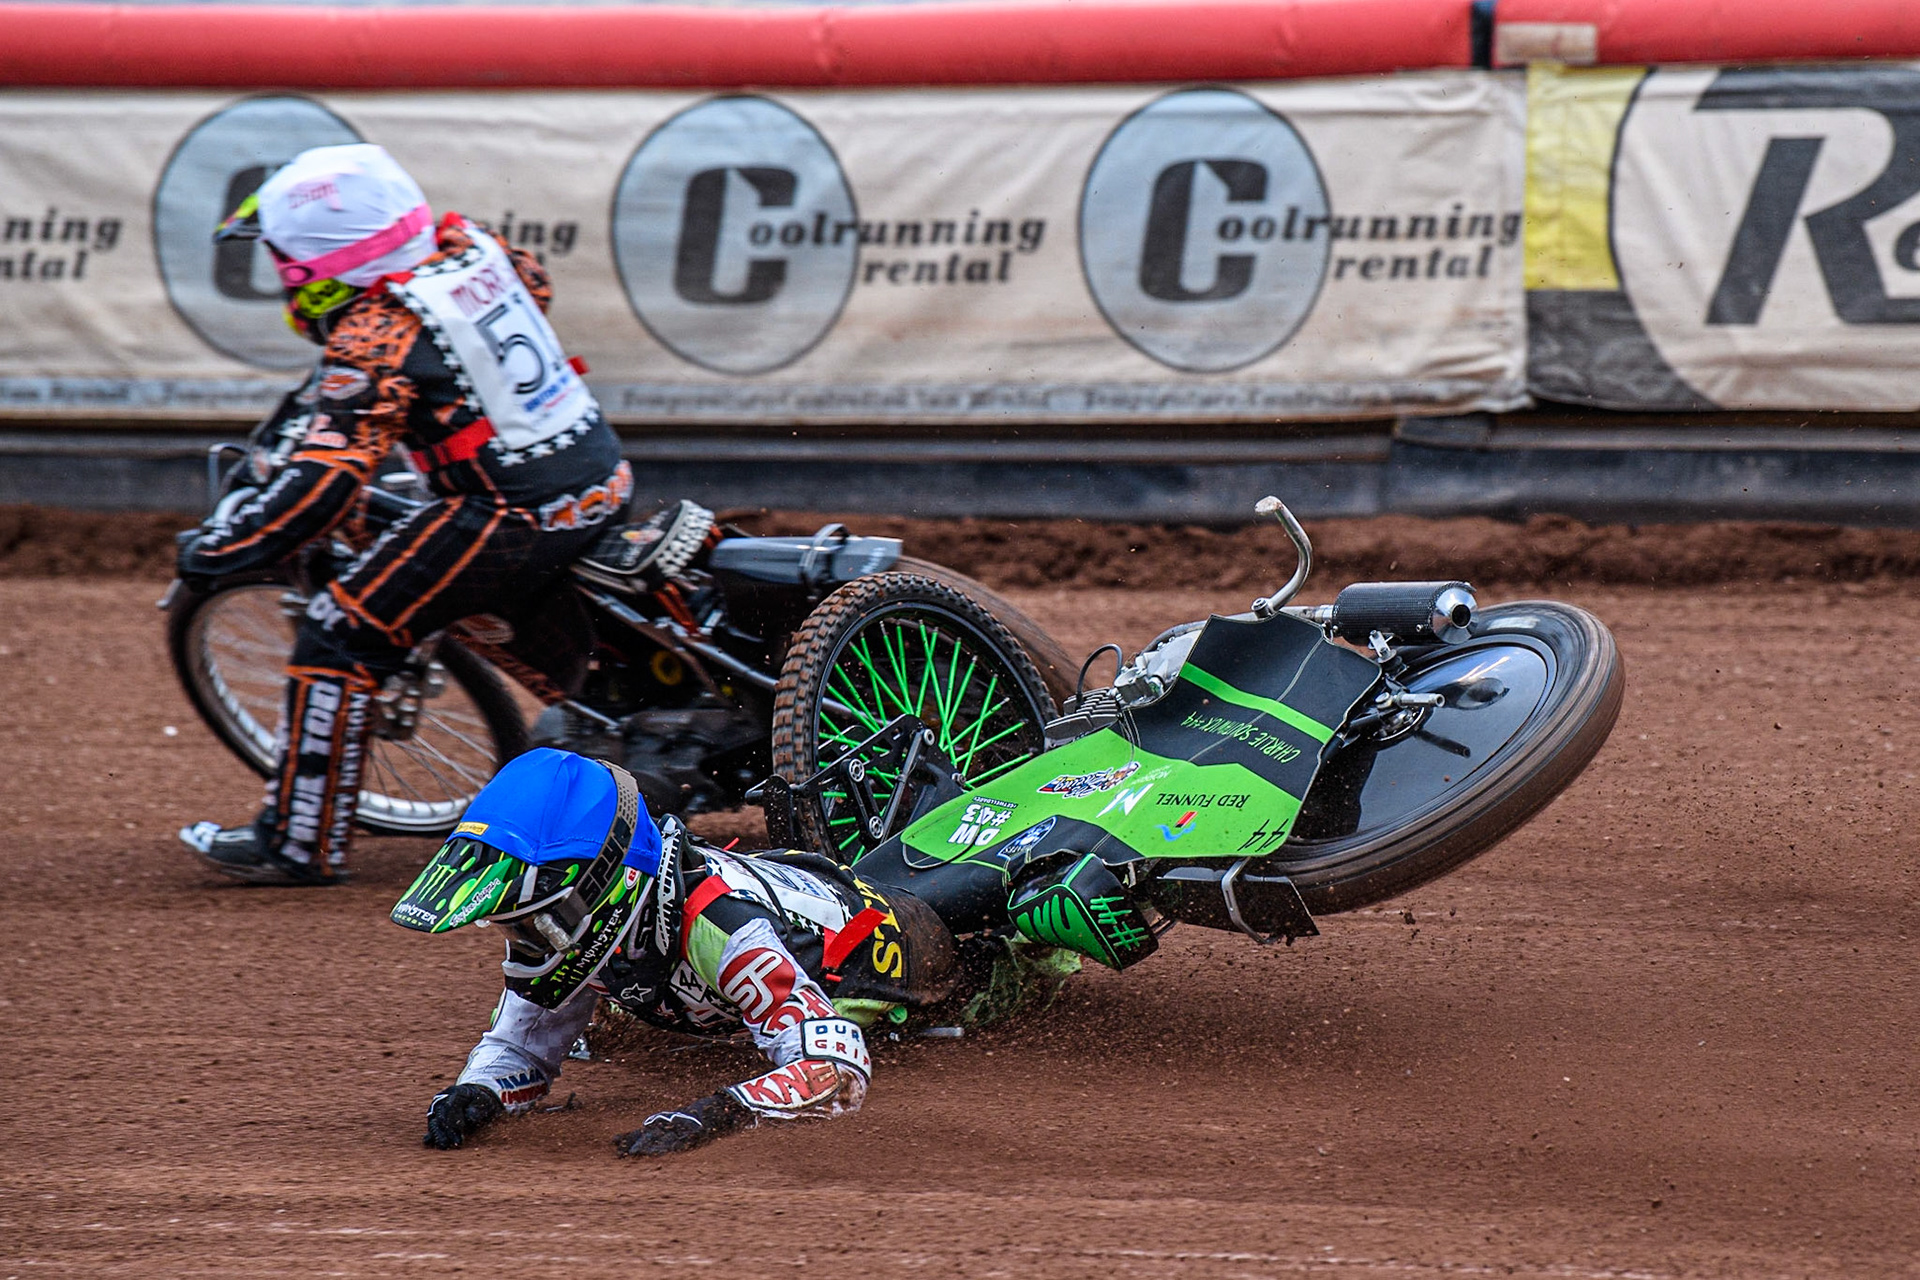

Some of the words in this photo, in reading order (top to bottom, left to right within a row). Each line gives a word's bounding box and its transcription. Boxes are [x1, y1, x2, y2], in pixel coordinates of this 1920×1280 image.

[1693, 66, 1920, 326] R
[864, 250, 1012, 284] rental
[1334, 247, 1493, 283] rental
[1247, 731, 1302, 764] CHARLIE
[1155, 792, 1213, 807] FUNNEL
[1217, 793, 1250, 808] RED
[961, 803, 1012, 826] #43
[948, 823, 1000, 846] DW
[1237, 818, 1290, 852] 44
[397, 902, 438, 925] MONSTER
[576, 906, 624, 968] MONSTER
[814, 1024, 862, 1043] DUR
